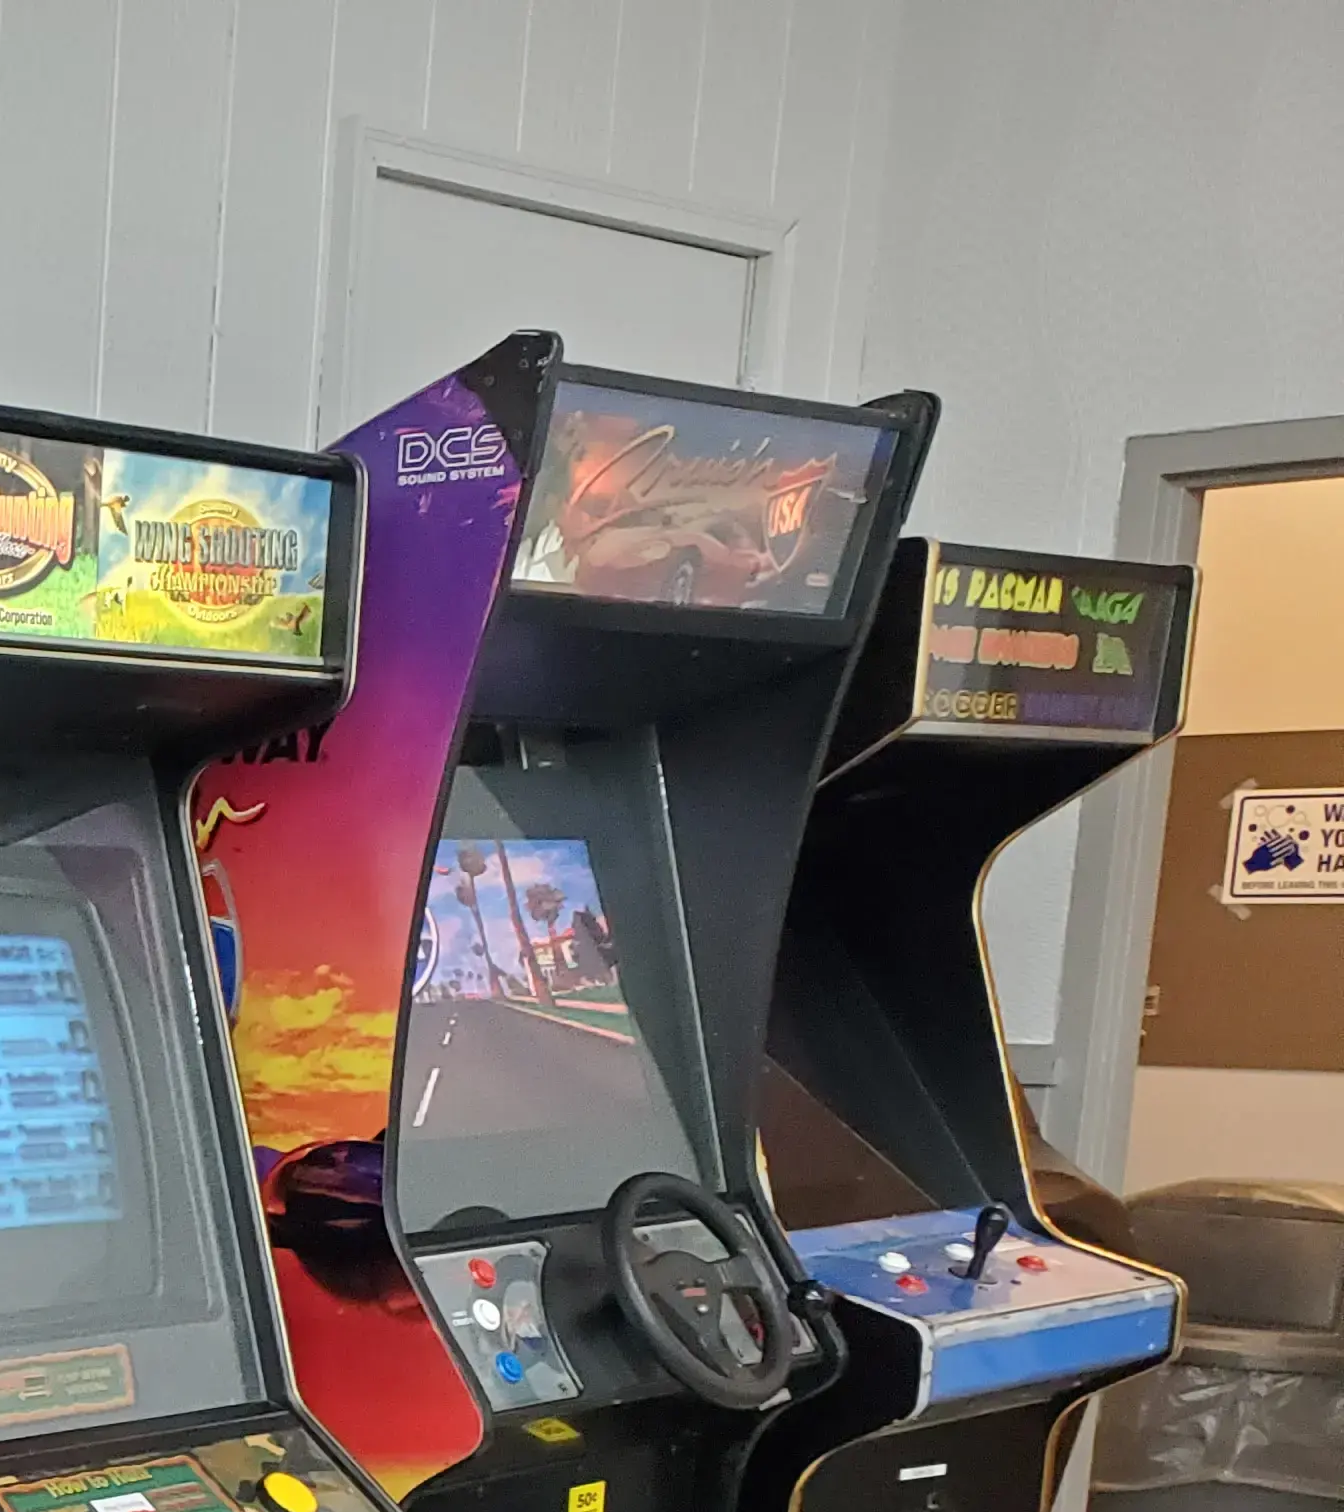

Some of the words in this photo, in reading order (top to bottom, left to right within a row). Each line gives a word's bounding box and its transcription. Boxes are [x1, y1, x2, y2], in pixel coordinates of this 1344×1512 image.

[397, 424, 507, 474] DCS
[398, 469, 447, 486] SOUND
[450, 464, 505, 482] SYSTEM
[769, 488, 809, 538] USA
[135, 519, 193, 563] WING
[199, 524, 299, 571] SHOOTING
[966, 568, 1064, 614] PACMAN
[186, 604, 239, 622] Outdoors
[43, 1476, 89, 1499] How
[88, 1475, 109, 1492] to
[576, 1492, 598, 1508] 50¢
